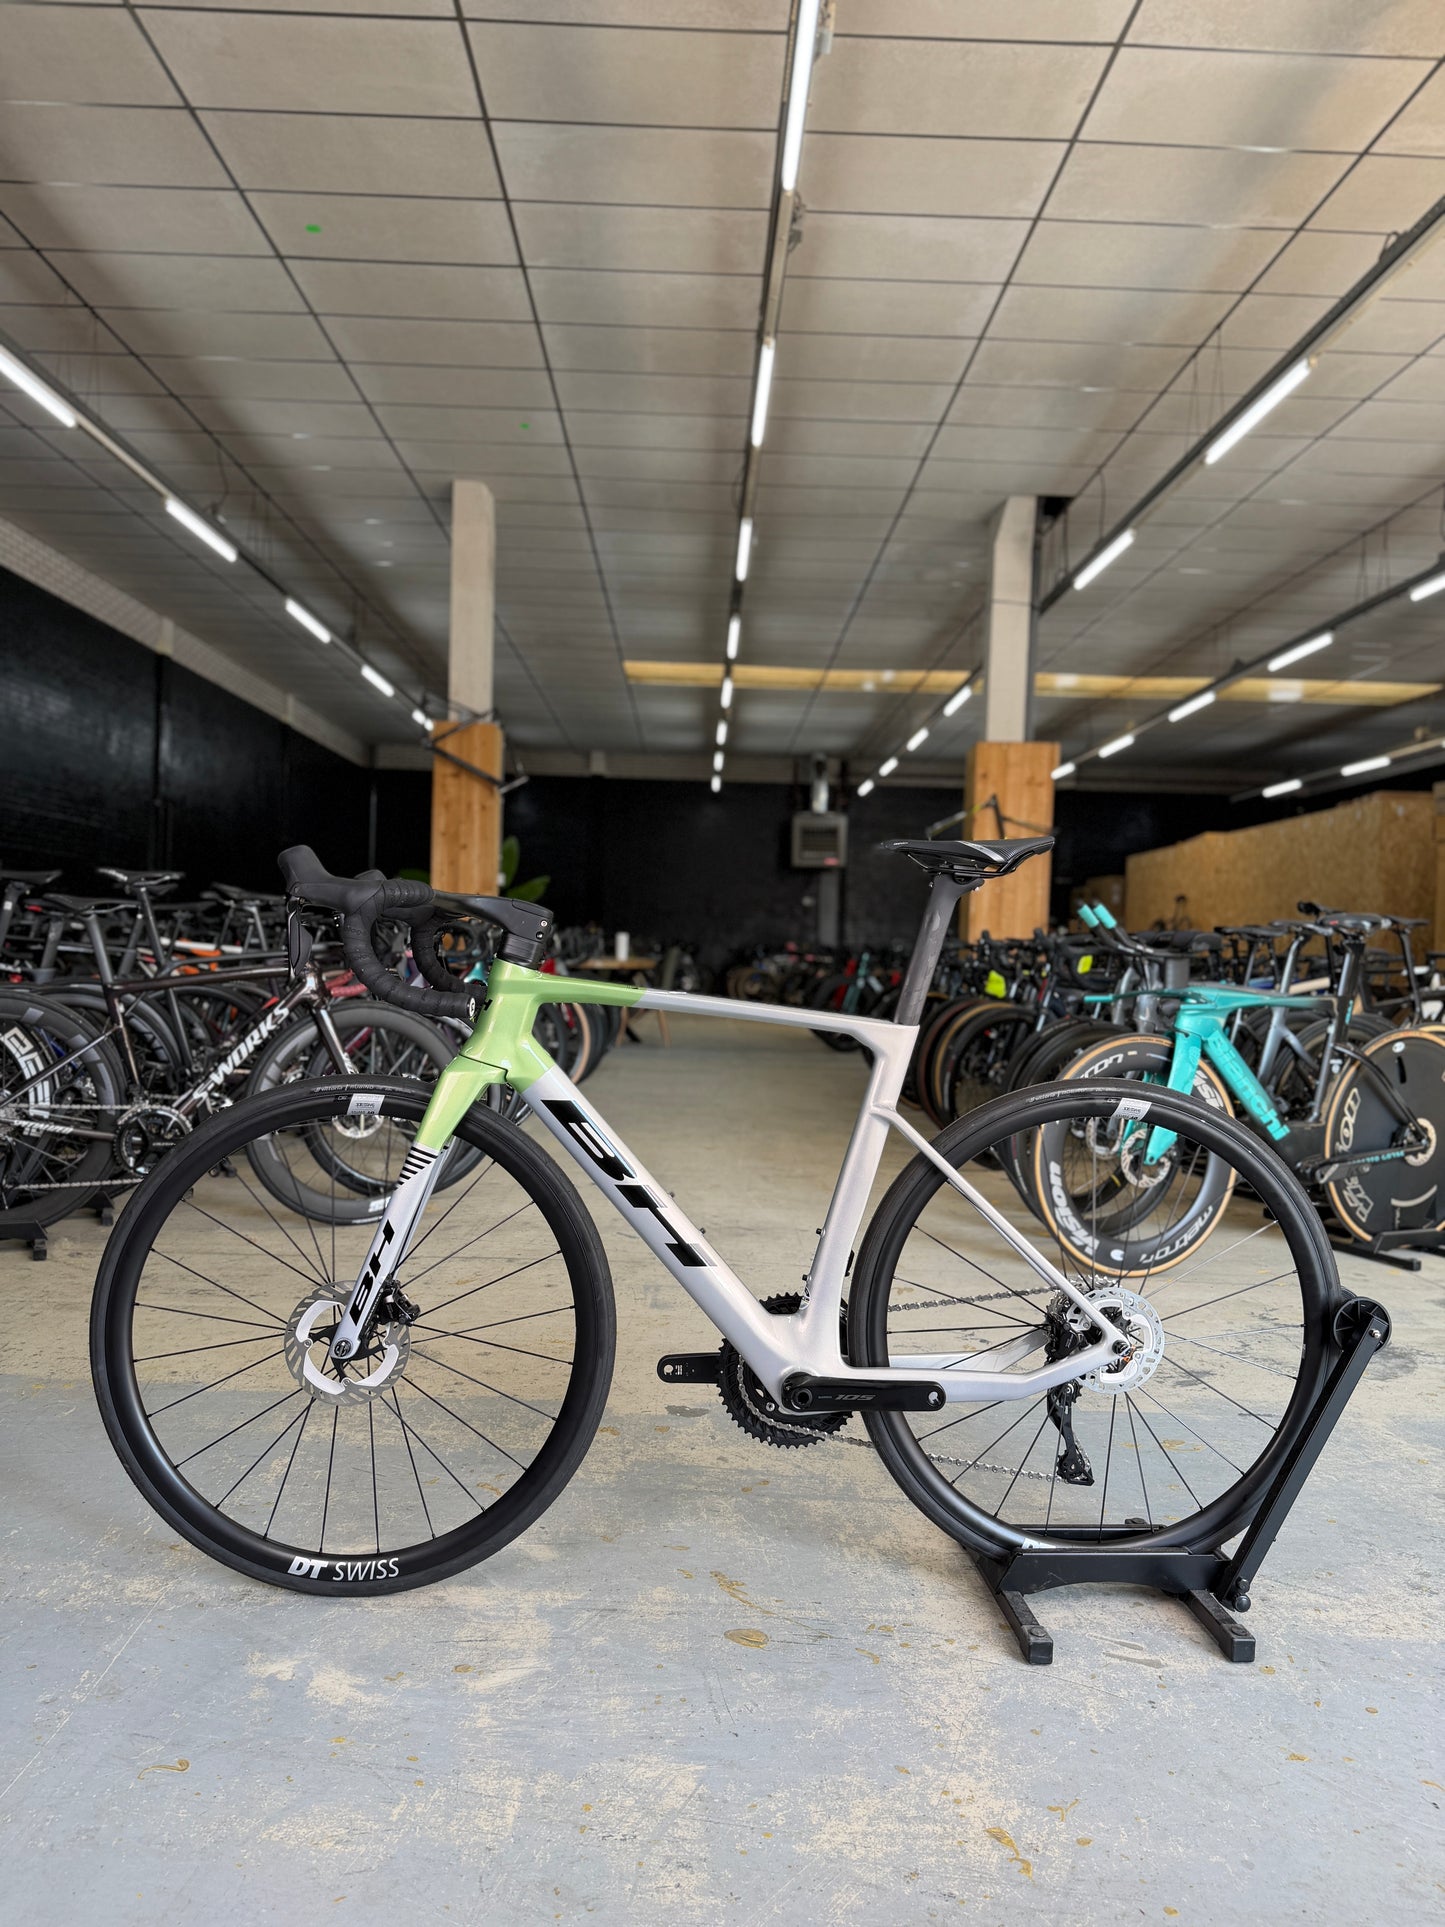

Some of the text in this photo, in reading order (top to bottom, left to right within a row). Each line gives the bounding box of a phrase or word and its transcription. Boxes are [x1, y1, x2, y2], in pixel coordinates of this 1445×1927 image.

[193, 1000, 290, 1108] S-WORKS
[1206, 1030, 1291, 1141] Bianchi
[539, 1099, 717, 1267] BH
[349, 1219, 395, 1327] BH
[287, 1555, 400, 1581] DT SWISS
